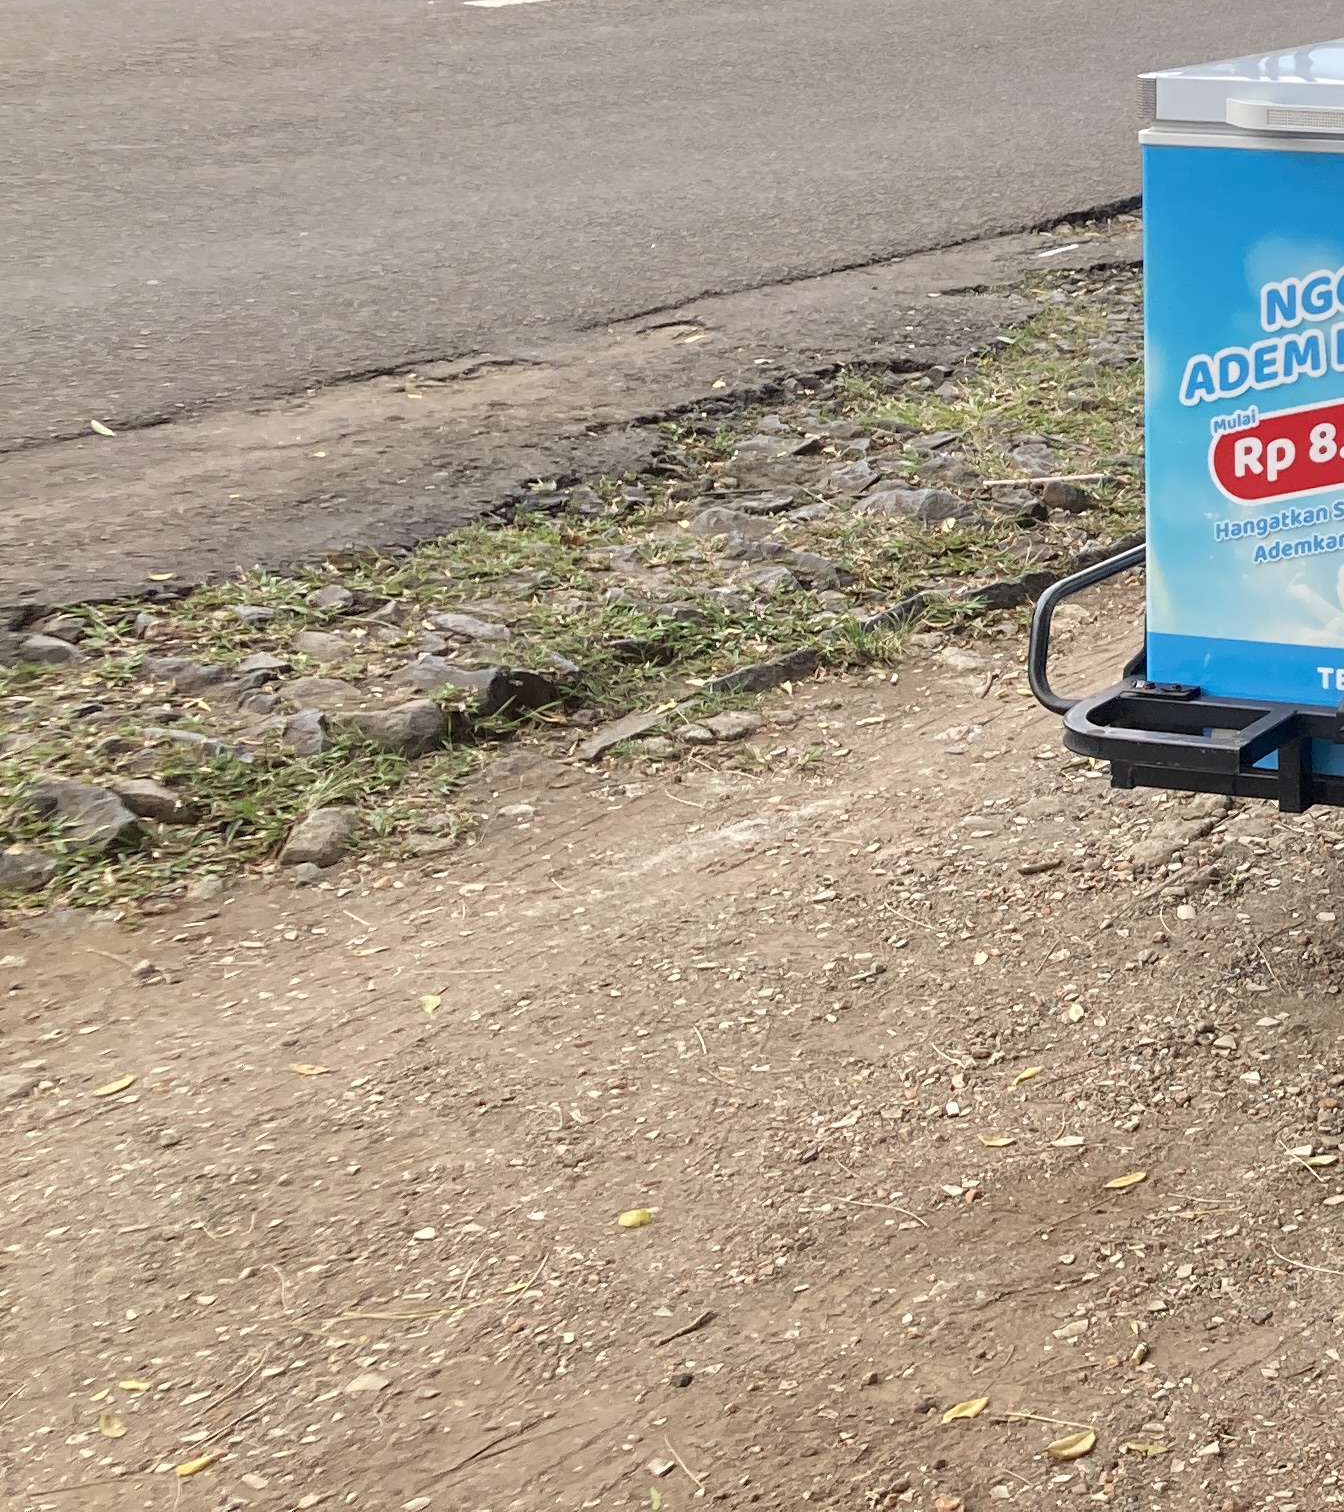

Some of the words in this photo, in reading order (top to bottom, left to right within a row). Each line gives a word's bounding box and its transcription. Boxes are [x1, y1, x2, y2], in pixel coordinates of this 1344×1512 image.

[1180, 329, 1325, 405] ADEM
[1212, 408, 1258, 434] Mulai
[1233, 437, 1296, 482] Rp
[1215, 506, 1330, 540] Hangatkan
